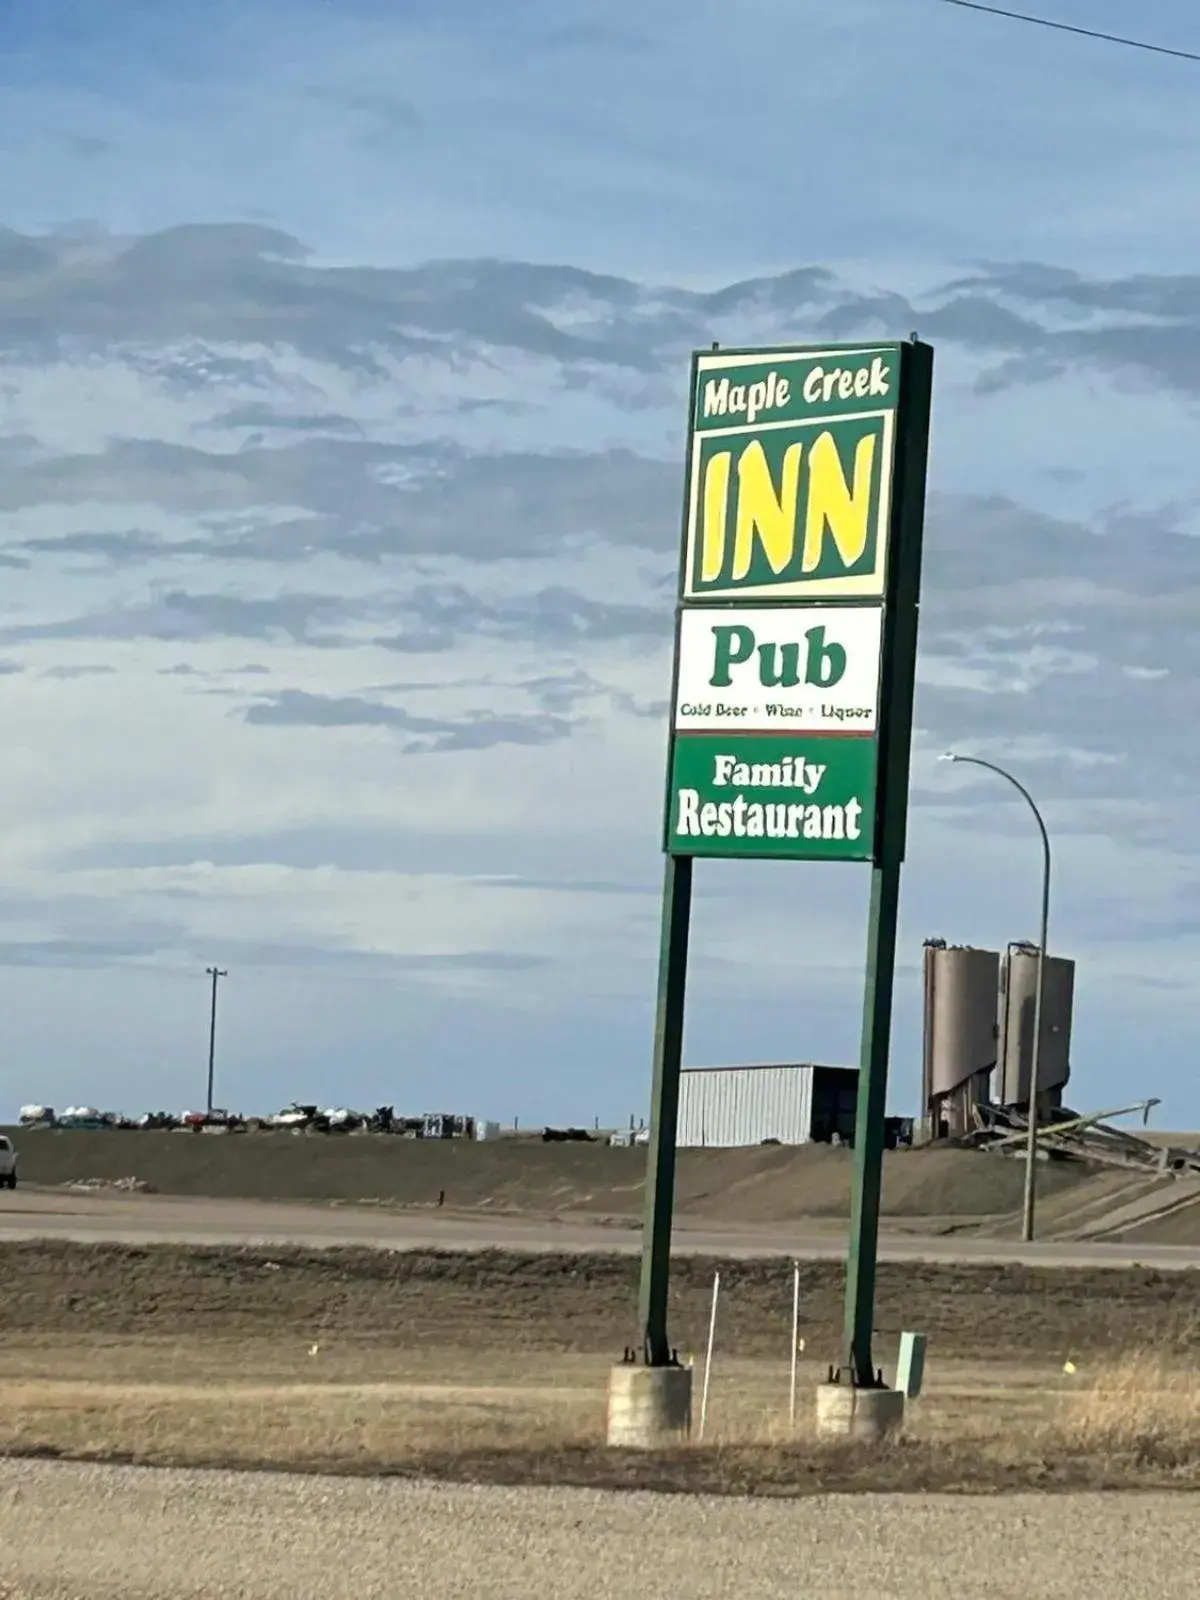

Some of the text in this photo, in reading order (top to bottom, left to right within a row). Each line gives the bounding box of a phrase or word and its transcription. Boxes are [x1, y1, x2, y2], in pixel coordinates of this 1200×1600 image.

[704, 357, 890, 423] Maple Creek
[701, 431, 876, 582] INN
[708, 625, 847, 688] Pub
[712, 755, 826, 794] Family
[676, 789, 862, 840] Restaurant
